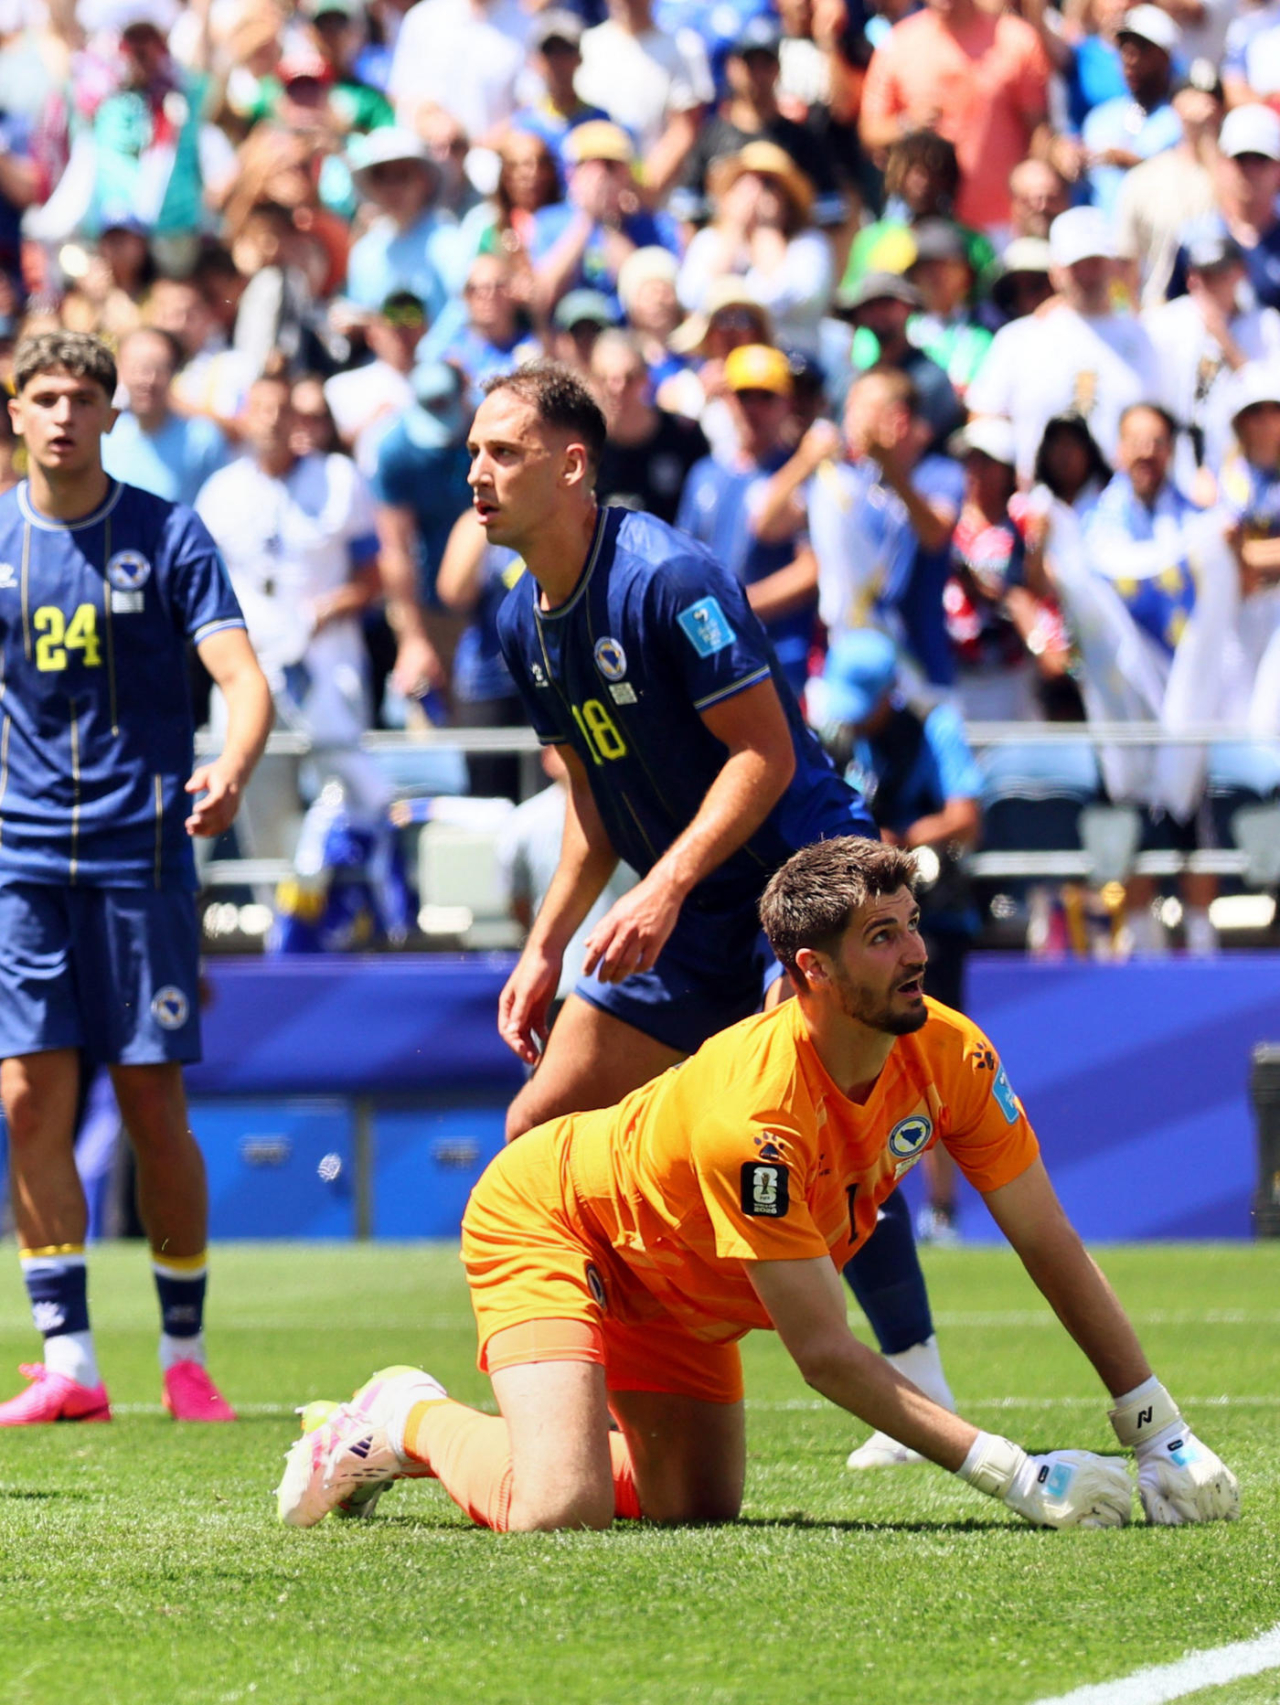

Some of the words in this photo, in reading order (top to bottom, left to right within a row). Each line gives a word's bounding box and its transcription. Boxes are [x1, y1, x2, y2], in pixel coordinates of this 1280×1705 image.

[33, 603, 102, 672] 24
[571, 699, 627, 765] 18
[845, 1182, 860, 1246] 1
